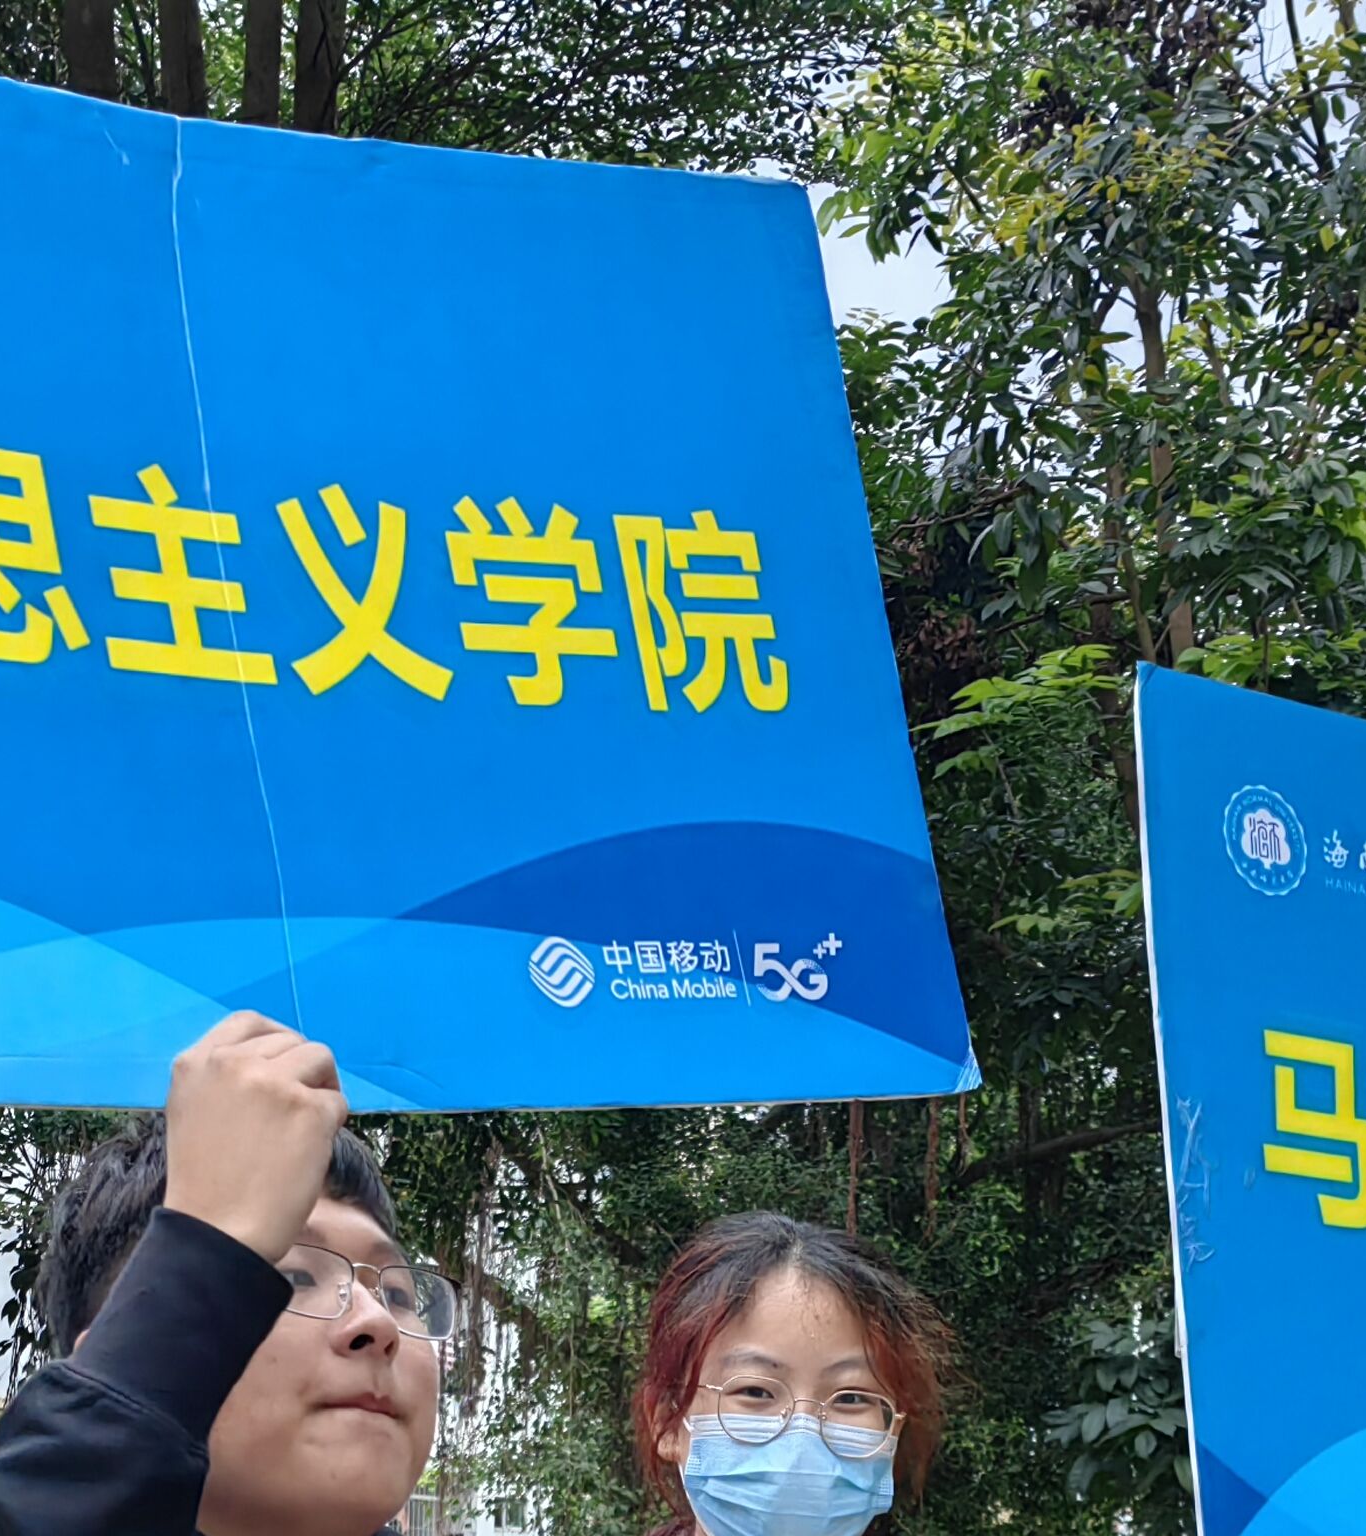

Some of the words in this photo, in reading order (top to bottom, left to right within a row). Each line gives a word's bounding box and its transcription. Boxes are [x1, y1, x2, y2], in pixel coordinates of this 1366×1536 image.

[602, 938, 733, 976] 中国移动
[610, 976, 670, 1001] China
[673, 975, 739, 1000] Mobile
